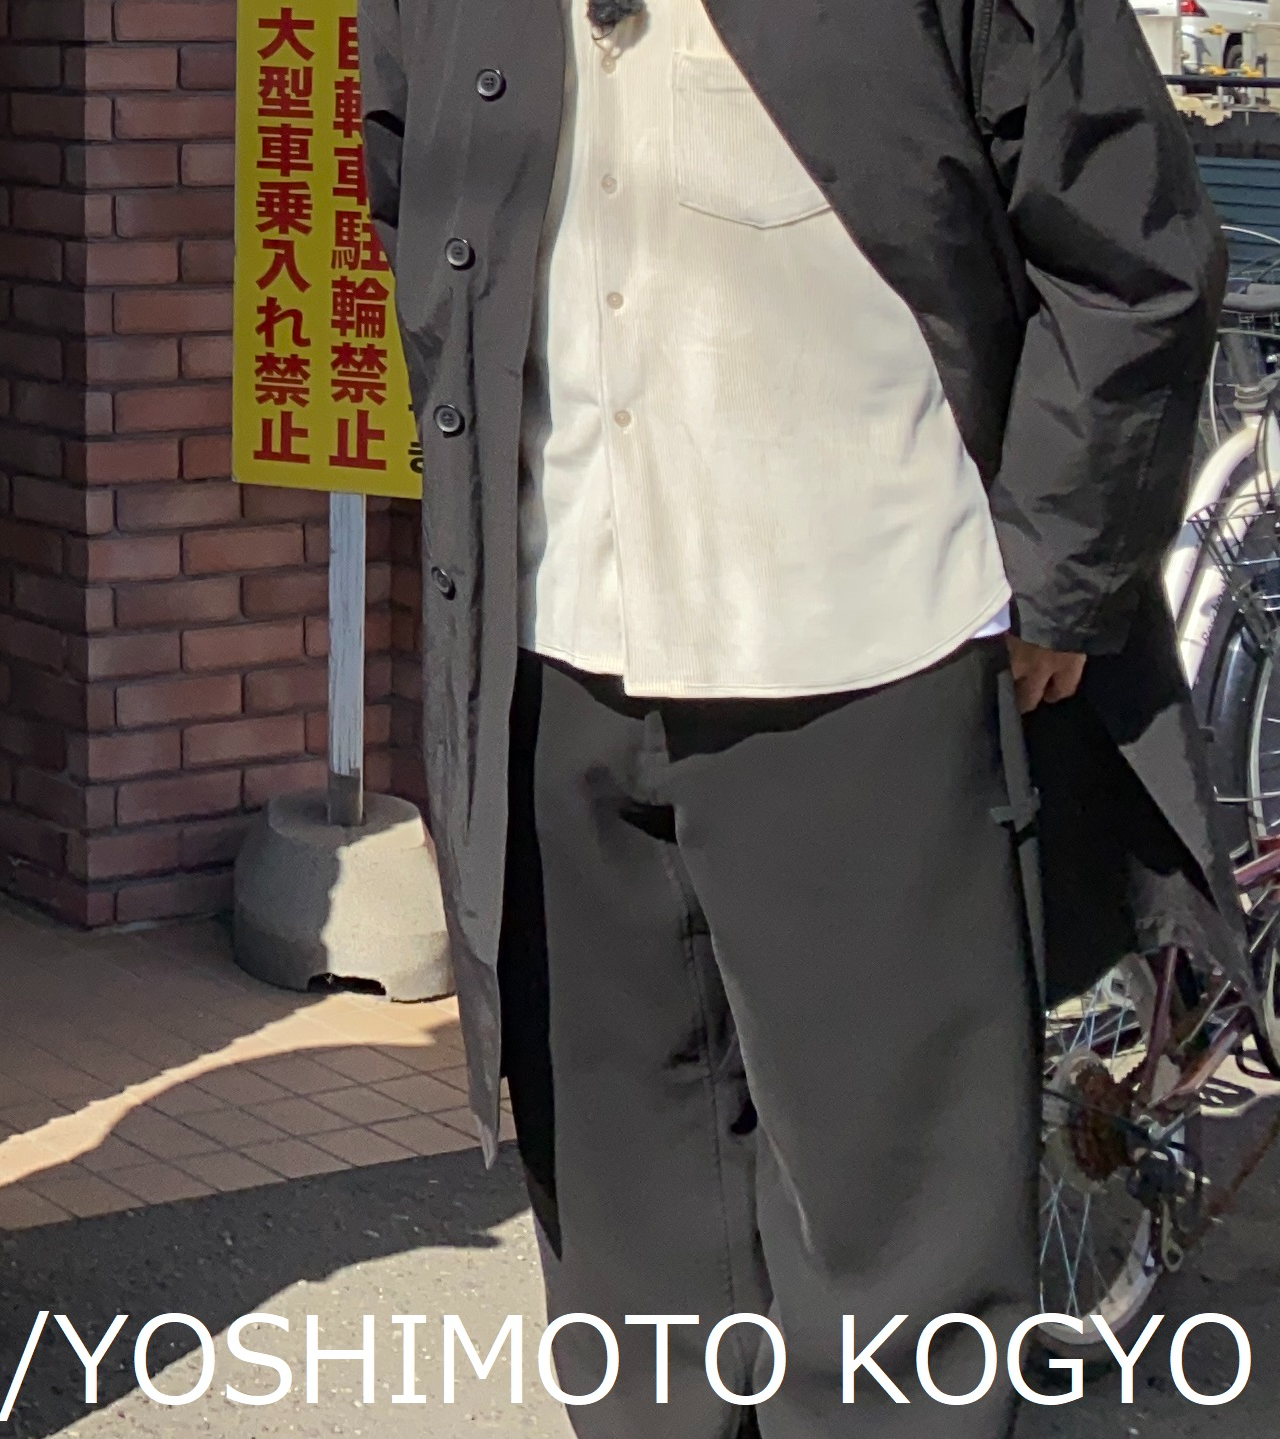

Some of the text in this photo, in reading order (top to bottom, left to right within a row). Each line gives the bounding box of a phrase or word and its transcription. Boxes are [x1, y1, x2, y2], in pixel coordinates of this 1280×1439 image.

[253, 7, 315, 465] 大型車乗入れ禁止
